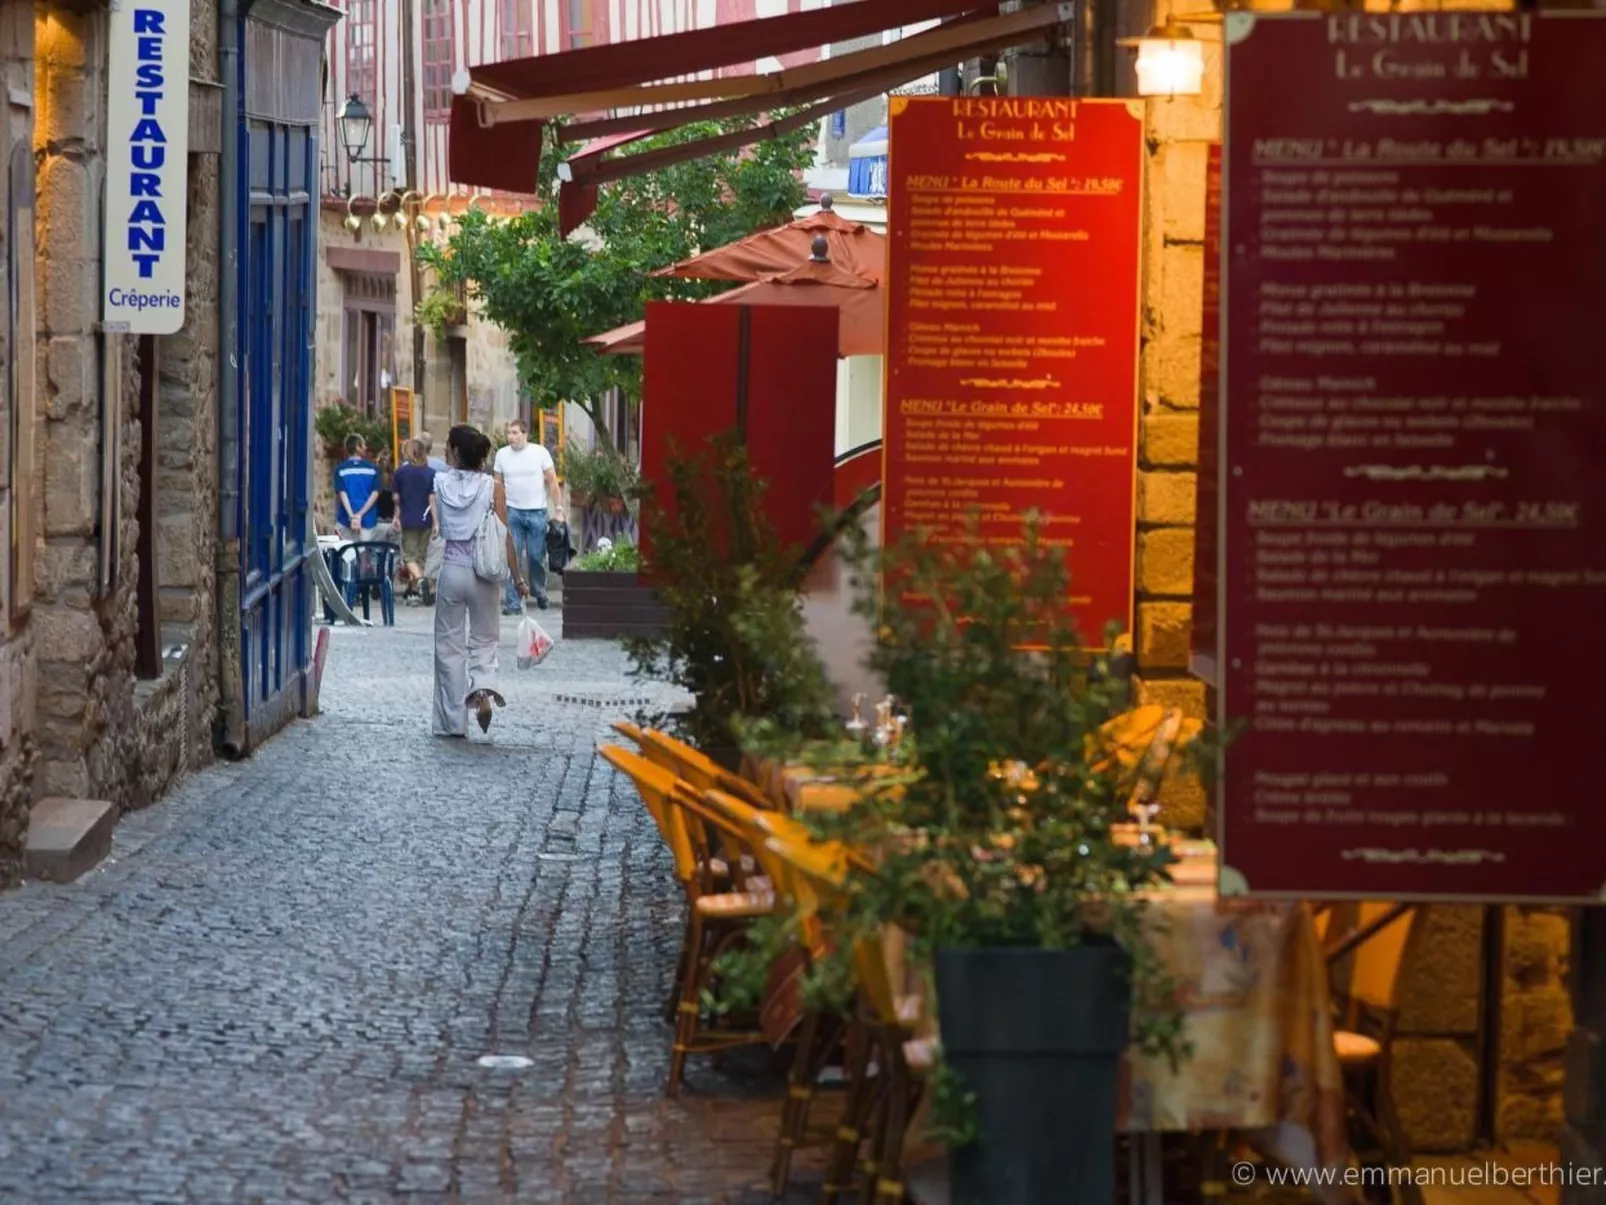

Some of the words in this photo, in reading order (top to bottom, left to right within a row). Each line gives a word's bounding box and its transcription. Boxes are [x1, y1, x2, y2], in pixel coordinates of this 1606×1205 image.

[1328, 13, 1532, 44] RESTAURANT
[1335, 48, 1363, 78] Le
[1372, 48, 1446, 78] Grain
[1489, 48, 1529, 78] Sel
[953, 100, 1077, 118] RESTAURANT
[958, 121, 974, 139] Le
[981, 121, 1025, 141] Grain
[1030, 121, 1046, 141] de
[1052, 121, 1074, 141] Sel
[128, 9, 168, 278] RESTAURANT
[962, 176, 978, 189] La
[982, 177, 1021, 189] Route
[1024, 177, 1043, 189] du
[1047, 177, 1067, 189] Sel
[108, 288, 181, 312] Crêperie
[900, 399, 942, 414] MENU
[971, 400, 1008, 414] Grain
[1011, 401, 1029, 414] de
